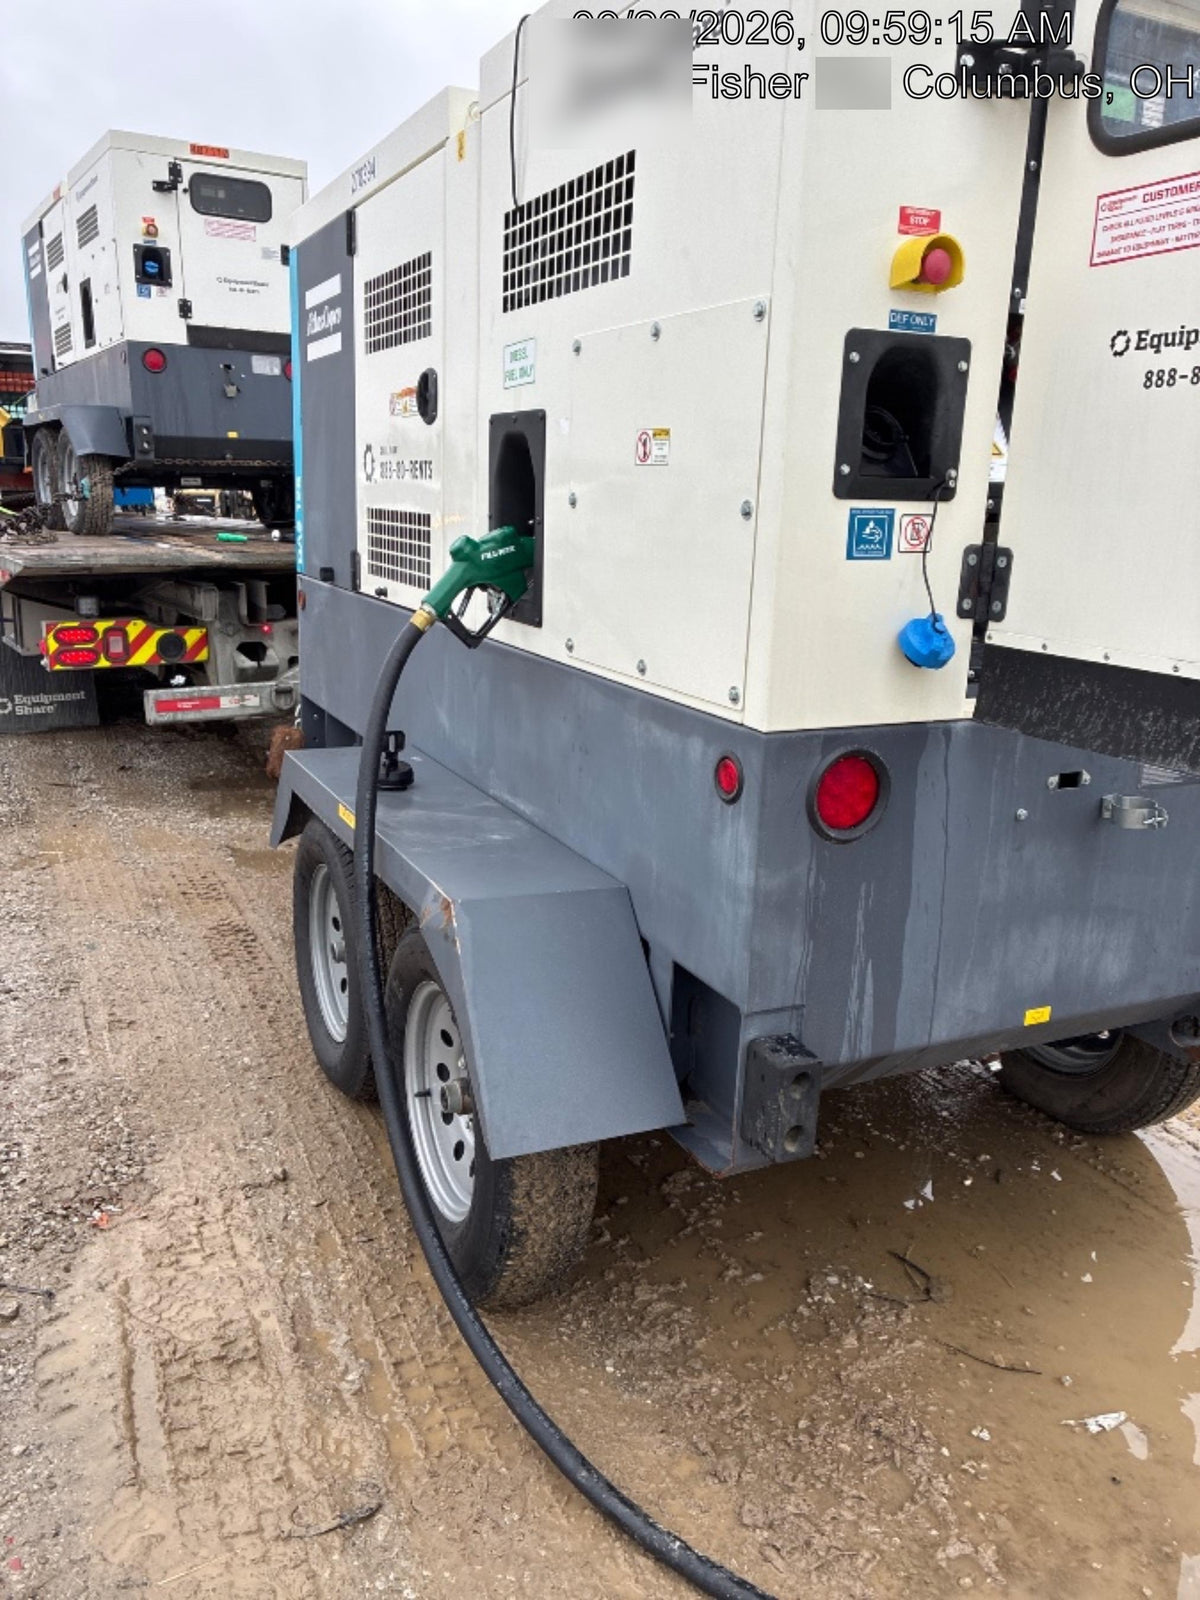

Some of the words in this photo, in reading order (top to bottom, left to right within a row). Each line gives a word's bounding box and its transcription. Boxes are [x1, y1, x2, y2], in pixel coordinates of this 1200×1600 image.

[909, 214, 930, 226] STOP
[890, 311, 910, 325] DEF
[910, 313, 935, 328] ONLY
[13, 690, 87, 706] Equipment
[15, 704, 55, 716] Share
